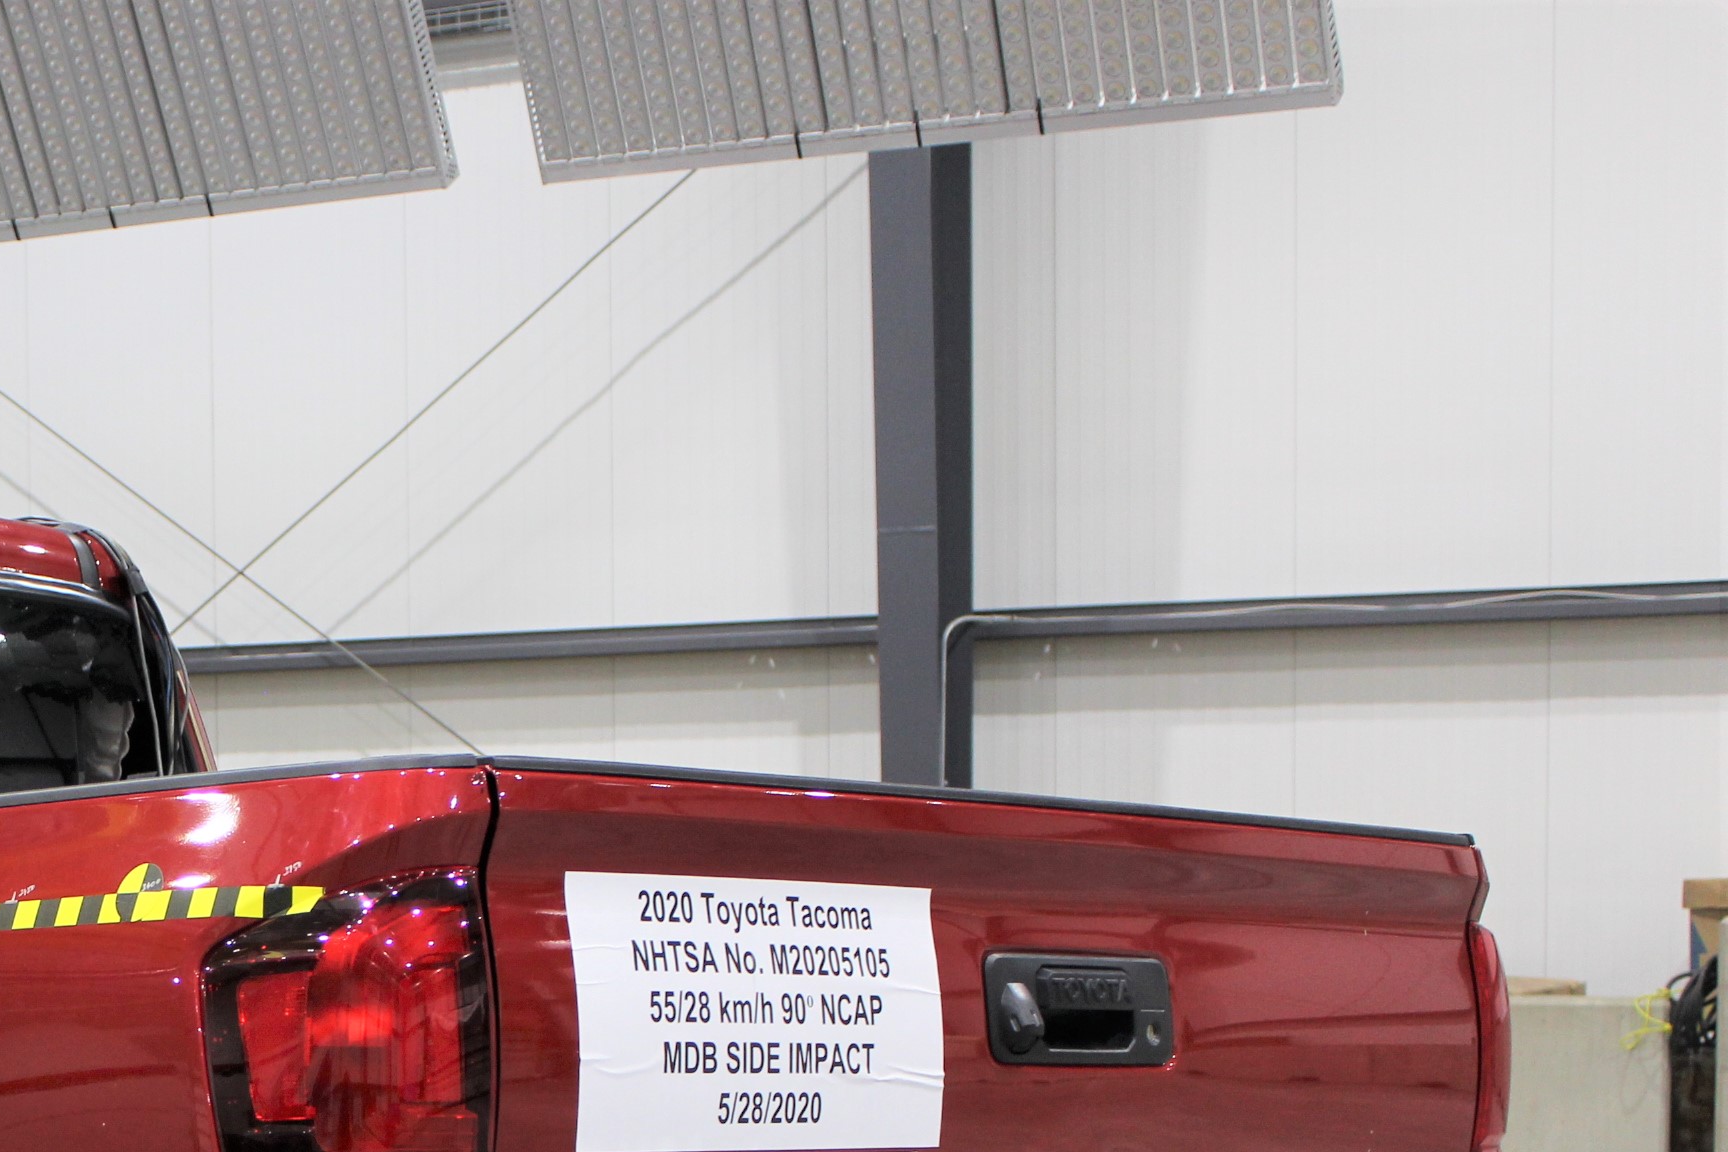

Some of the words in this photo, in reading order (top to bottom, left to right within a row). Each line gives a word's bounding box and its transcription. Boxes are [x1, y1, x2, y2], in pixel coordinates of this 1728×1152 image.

[638, 890, 693, 923] 2020
[701, 892, 780, 933] Toyota
[786, 896, 872, 930] Tacoma
[631, 939, 718, 973] NHTSA
[725, 942, 763, 974] No.
[770, 944, 890, 978] M20205105
[650, 990, 711, 1023] 55/28
[719, 992, 774, 1024] km/h
[821, 994, 882, 1026] NCAP
[664, 1041, 718, 1074] MDB
[726, 1041, 780, 1074] SIDE
[789, 1042, 874, 1075] IMPACT
[718, 1092, 822, 1125] 5/28/2020
